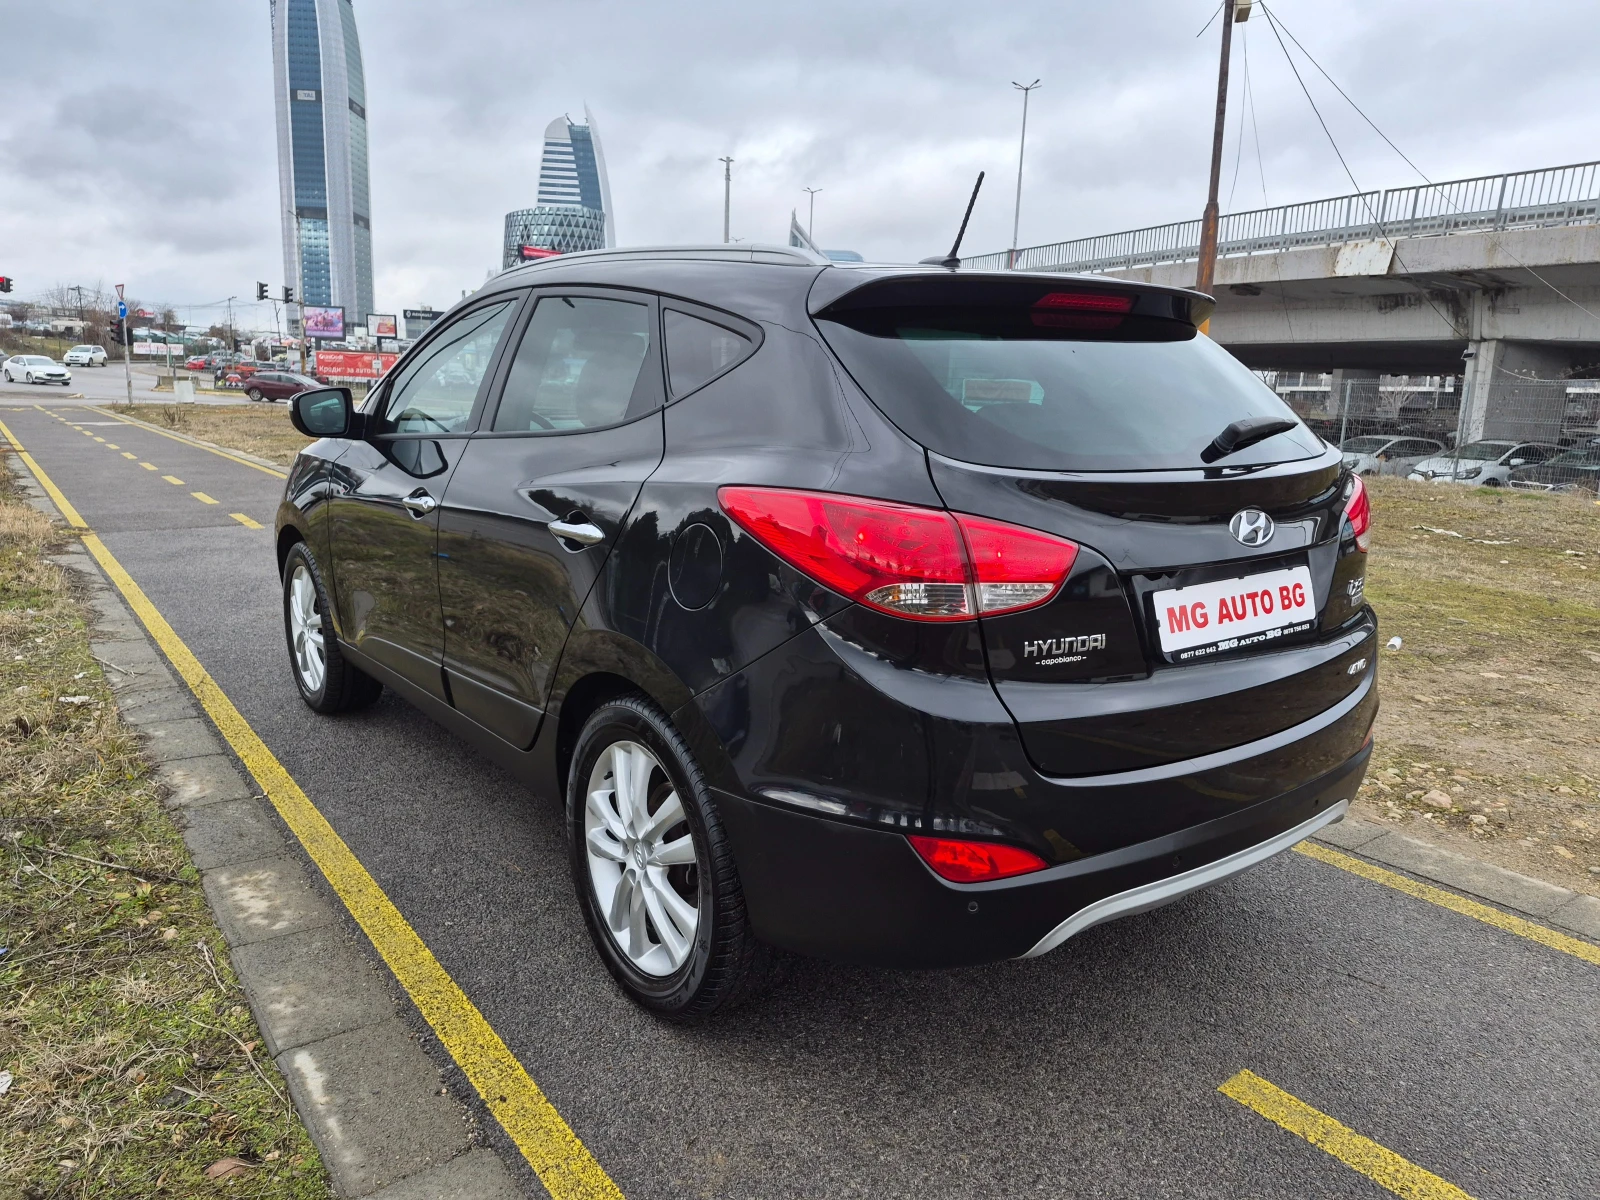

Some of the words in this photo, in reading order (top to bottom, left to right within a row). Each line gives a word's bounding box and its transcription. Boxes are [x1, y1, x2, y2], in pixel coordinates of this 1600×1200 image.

[1166, 601, 1209, 634] MG
[1217, 588, 1274, 625] AUTO
[1278, 582, 1306, 611] BG
[1023, 633, 1106, 658] HYUNDAI
[1180, 651, 1195, 660] 0877
[1217, 638, 1239, 651] MG
[1239, 635, 1266, 646] AUTO
[1265, 628, 1283, 640] BG
